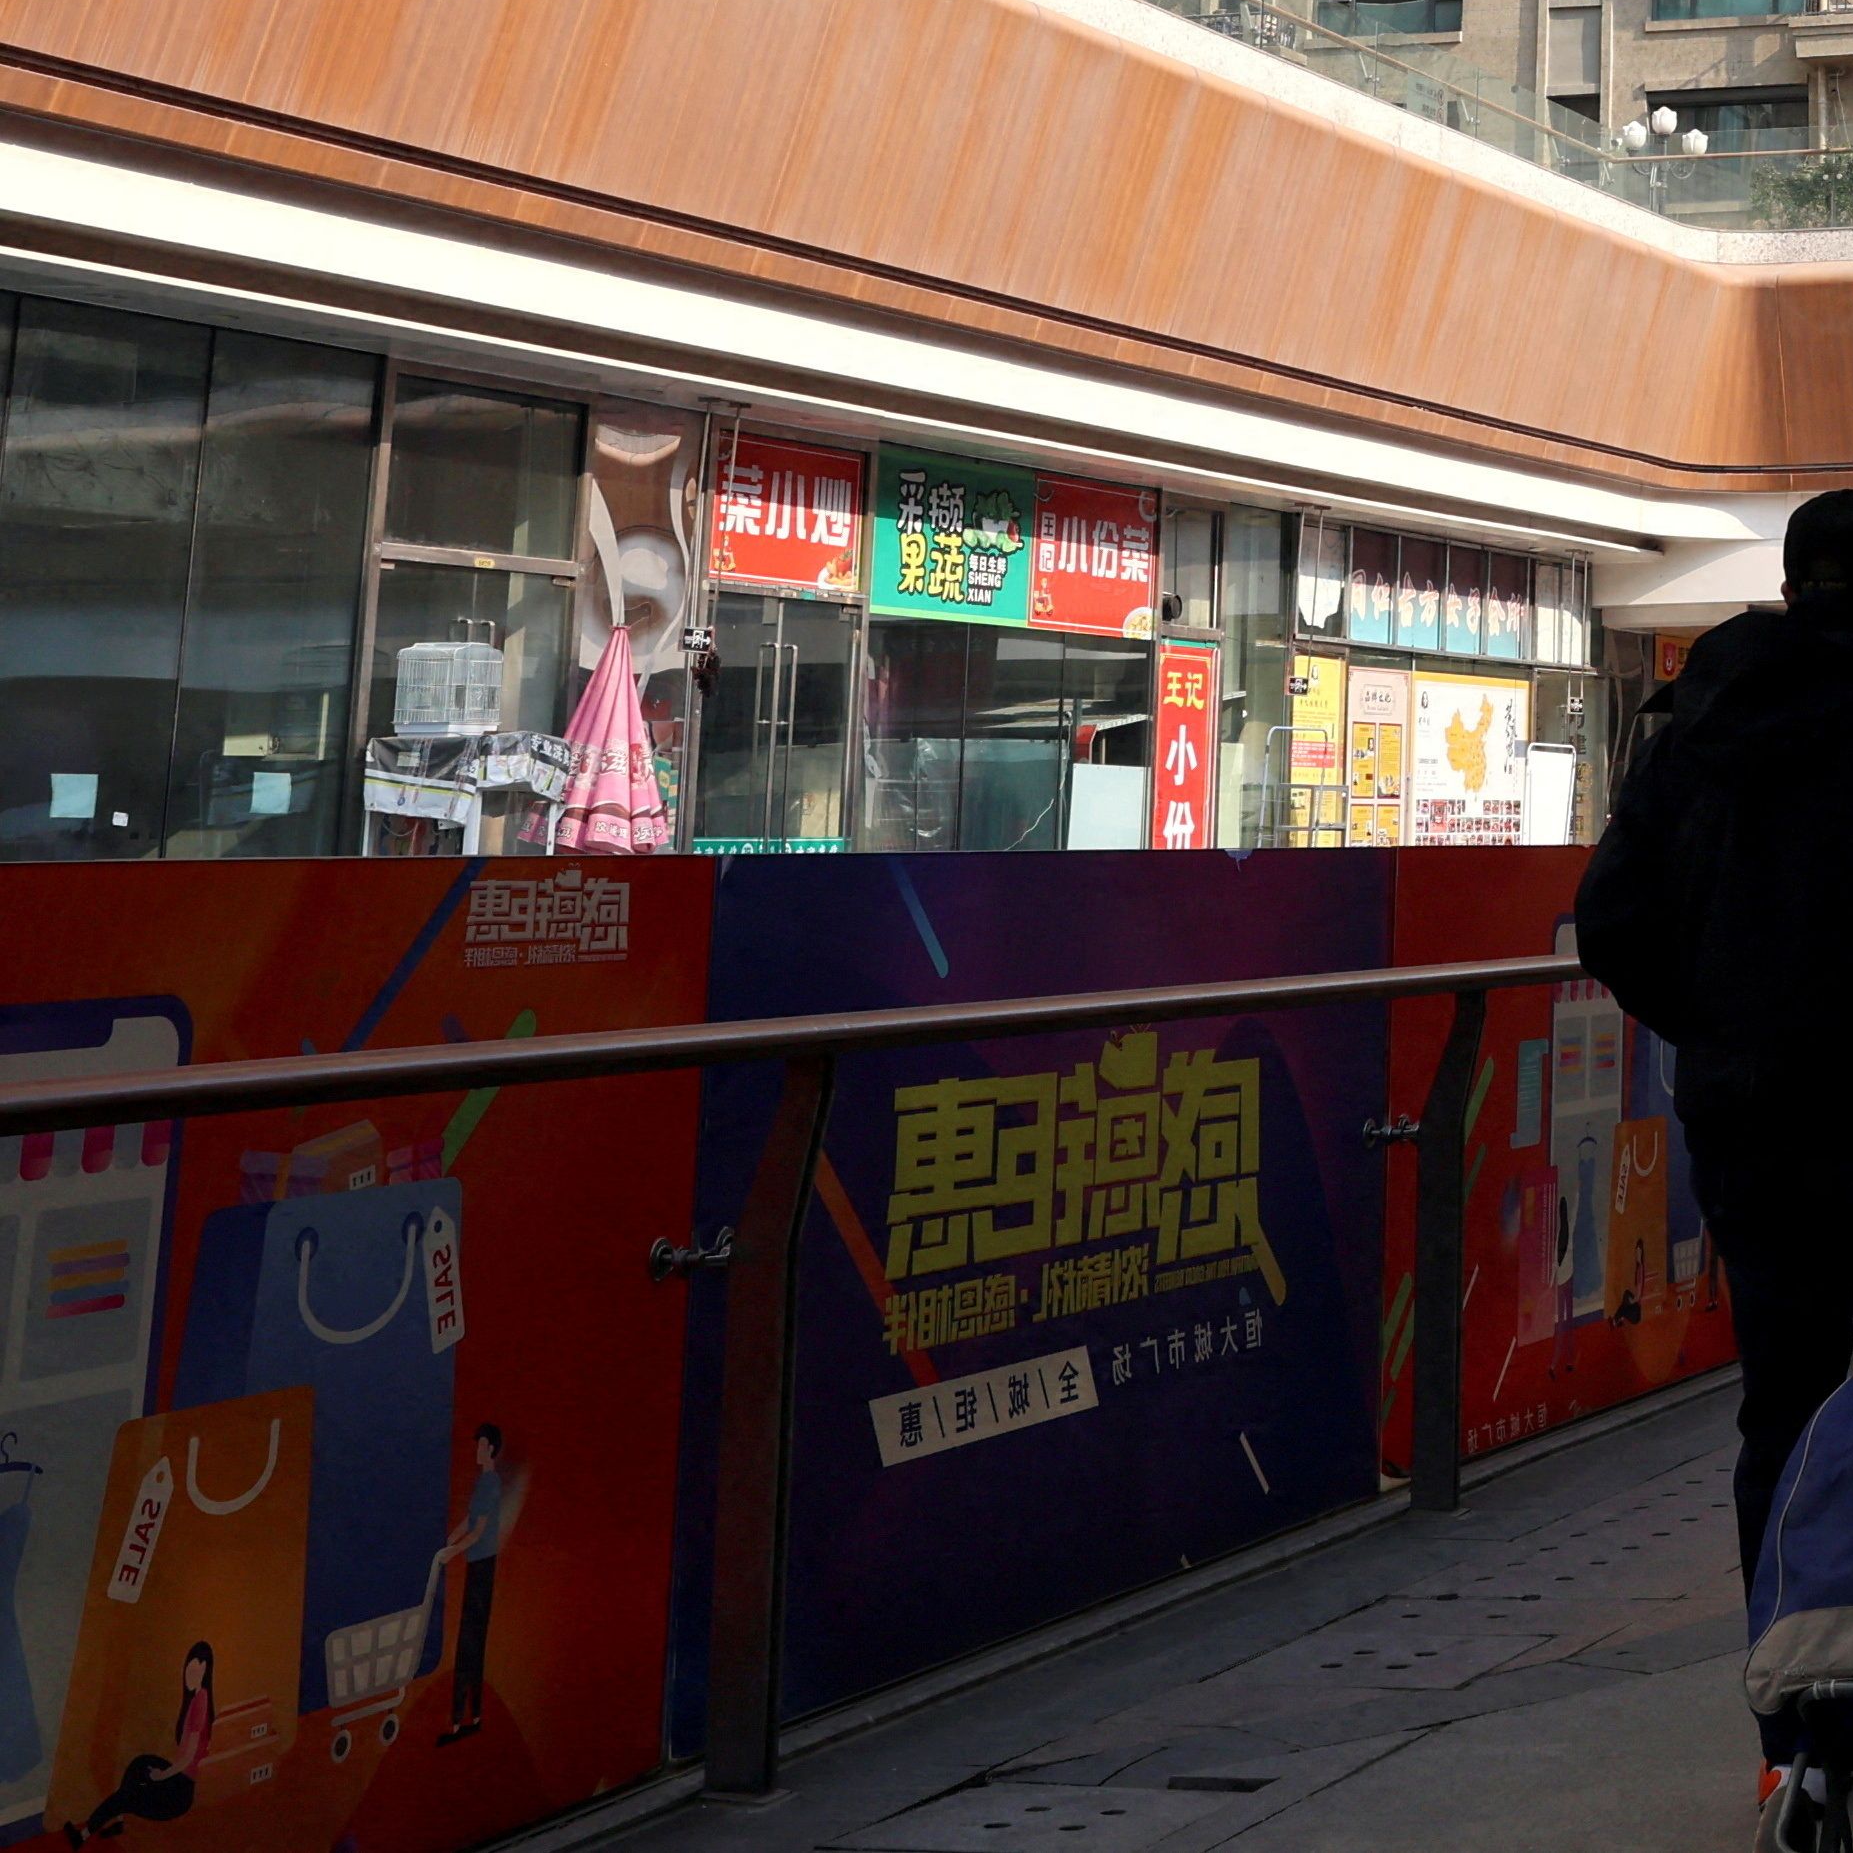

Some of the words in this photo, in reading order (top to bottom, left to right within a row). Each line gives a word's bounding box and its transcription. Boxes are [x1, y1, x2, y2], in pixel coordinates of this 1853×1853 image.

[718, 465, 852, 547] 菜小炒
[899, 533, 965, 603] 果蔬
[968, 552, 1008, 575] 每日生鲜
[1058, 516, 1149, 582] 小份菜
[966, 588, 992, 604] XIAN
[968, 571, 1002, 589] SHENG
[1163, 672, 1204, 710] 王记
